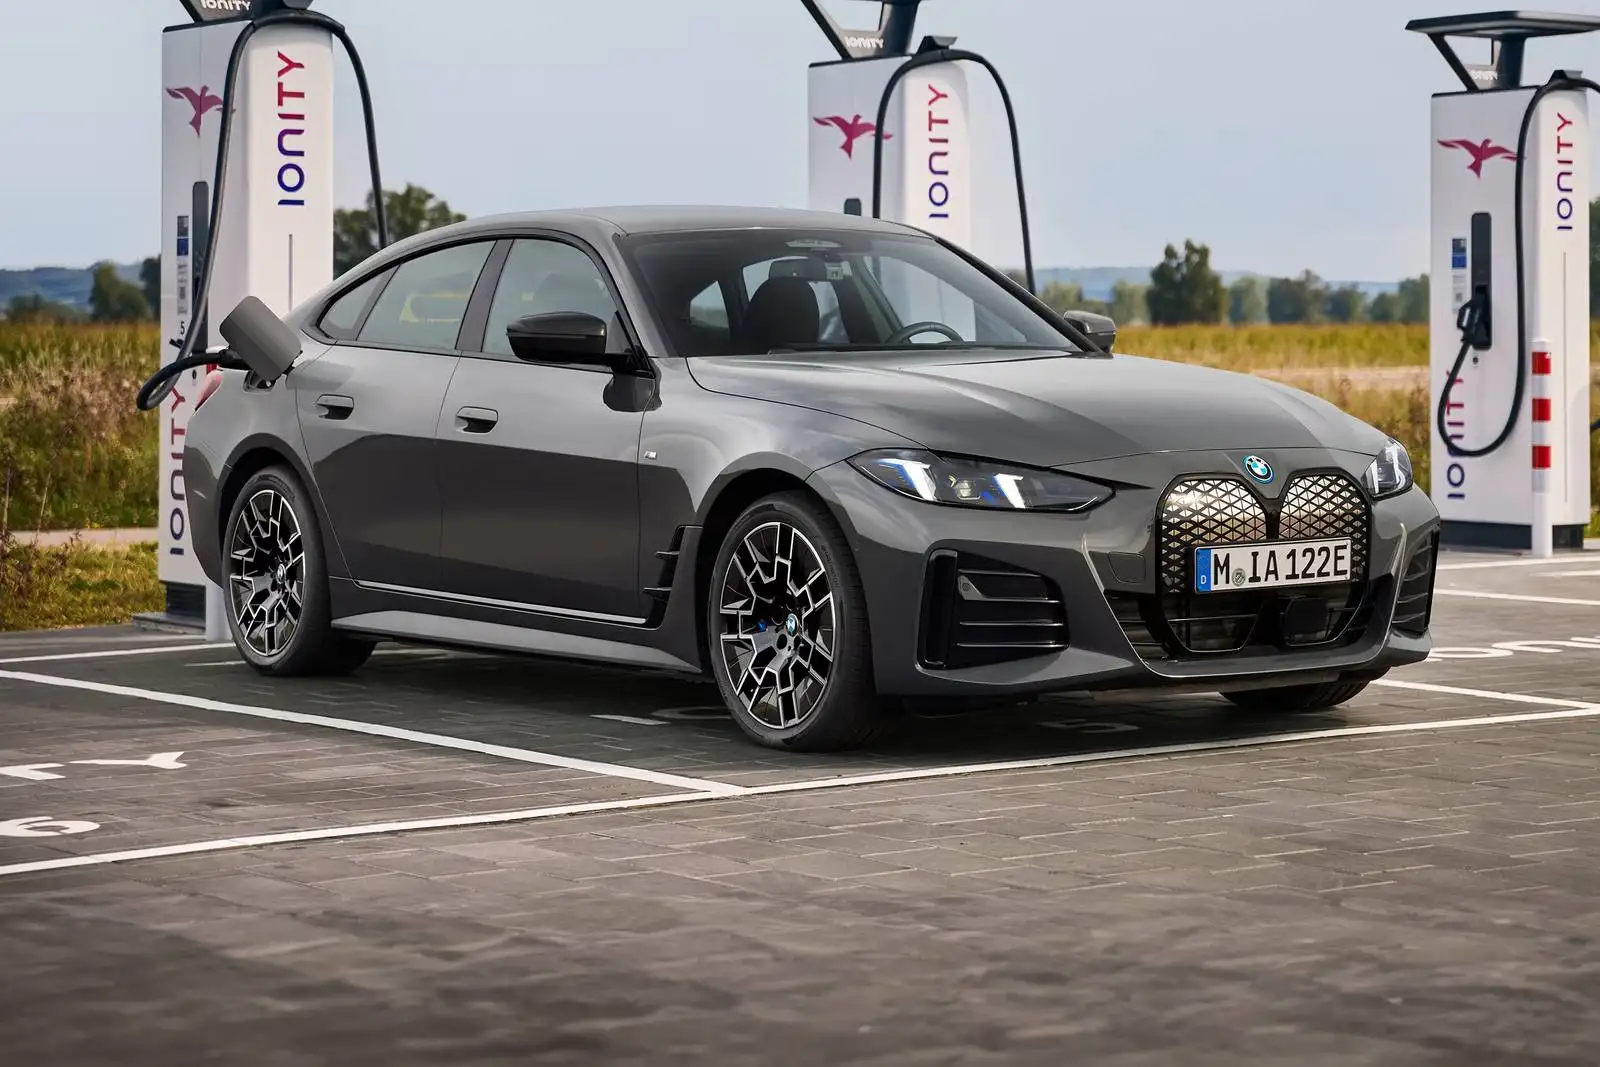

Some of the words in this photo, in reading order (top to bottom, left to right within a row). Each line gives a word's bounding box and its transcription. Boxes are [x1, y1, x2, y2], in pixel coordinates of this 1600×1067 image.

[277, 50, 305, 206] IONITY
[928, 84, 949, 219] IONITY
[1556, 112, 1574, 231] IONITY
[180, 321, 185, 335] 5
[1200, 574, 1207, 584] D
[1213, 553, 1230, 585] M
[1248, 549, 1279, 582] IA
[1285, 544, 1348, 580] 122E
